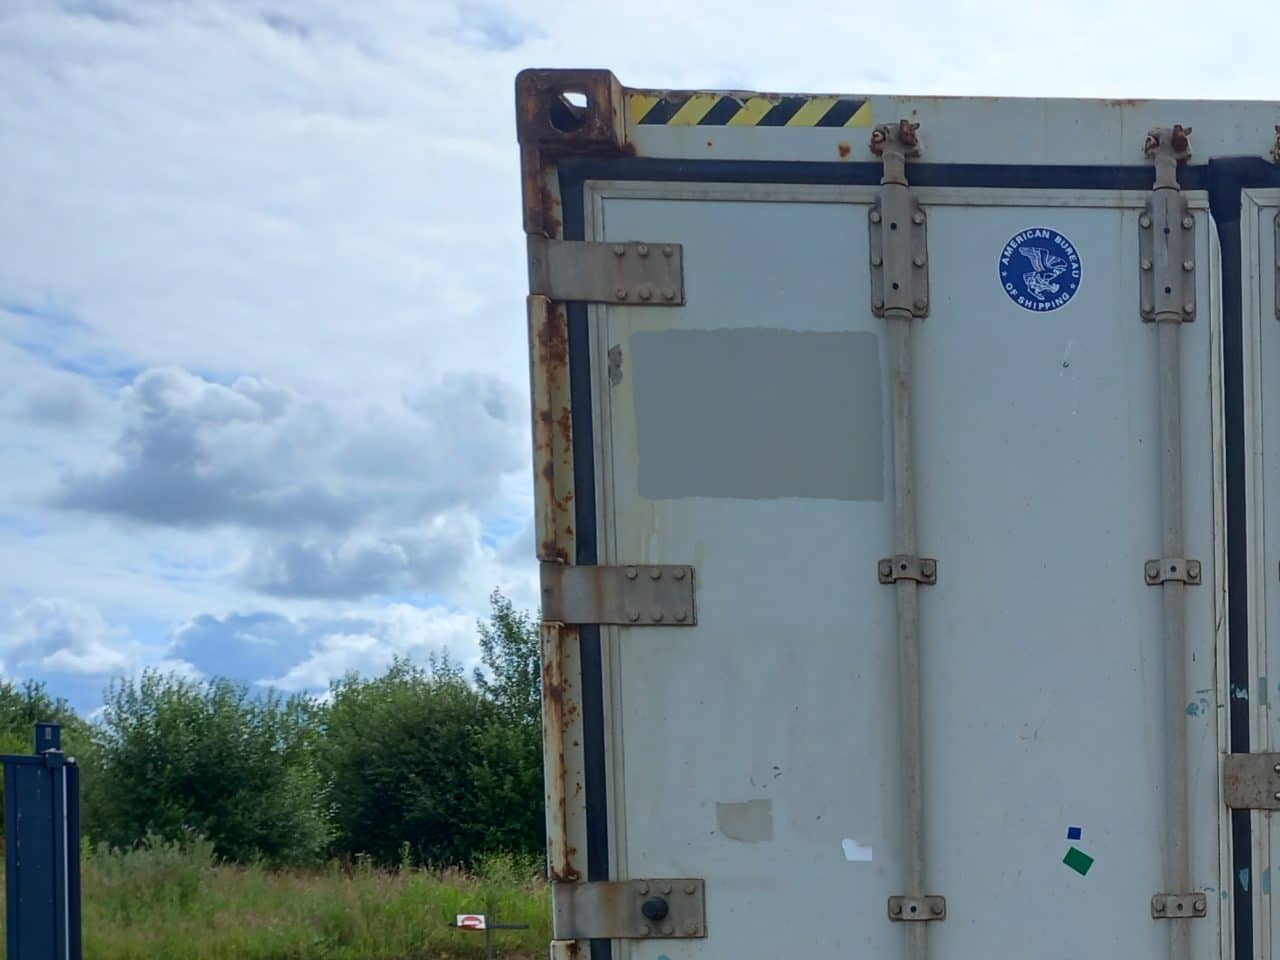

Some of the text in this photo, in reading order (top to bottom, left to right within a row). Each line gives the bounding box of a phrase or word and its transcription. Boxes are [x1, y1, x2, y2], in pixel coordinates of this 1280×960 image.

[1002, 230, 1079, 278] AMERICAN BUREAU
[1006, 283, 1017, 296] OF
